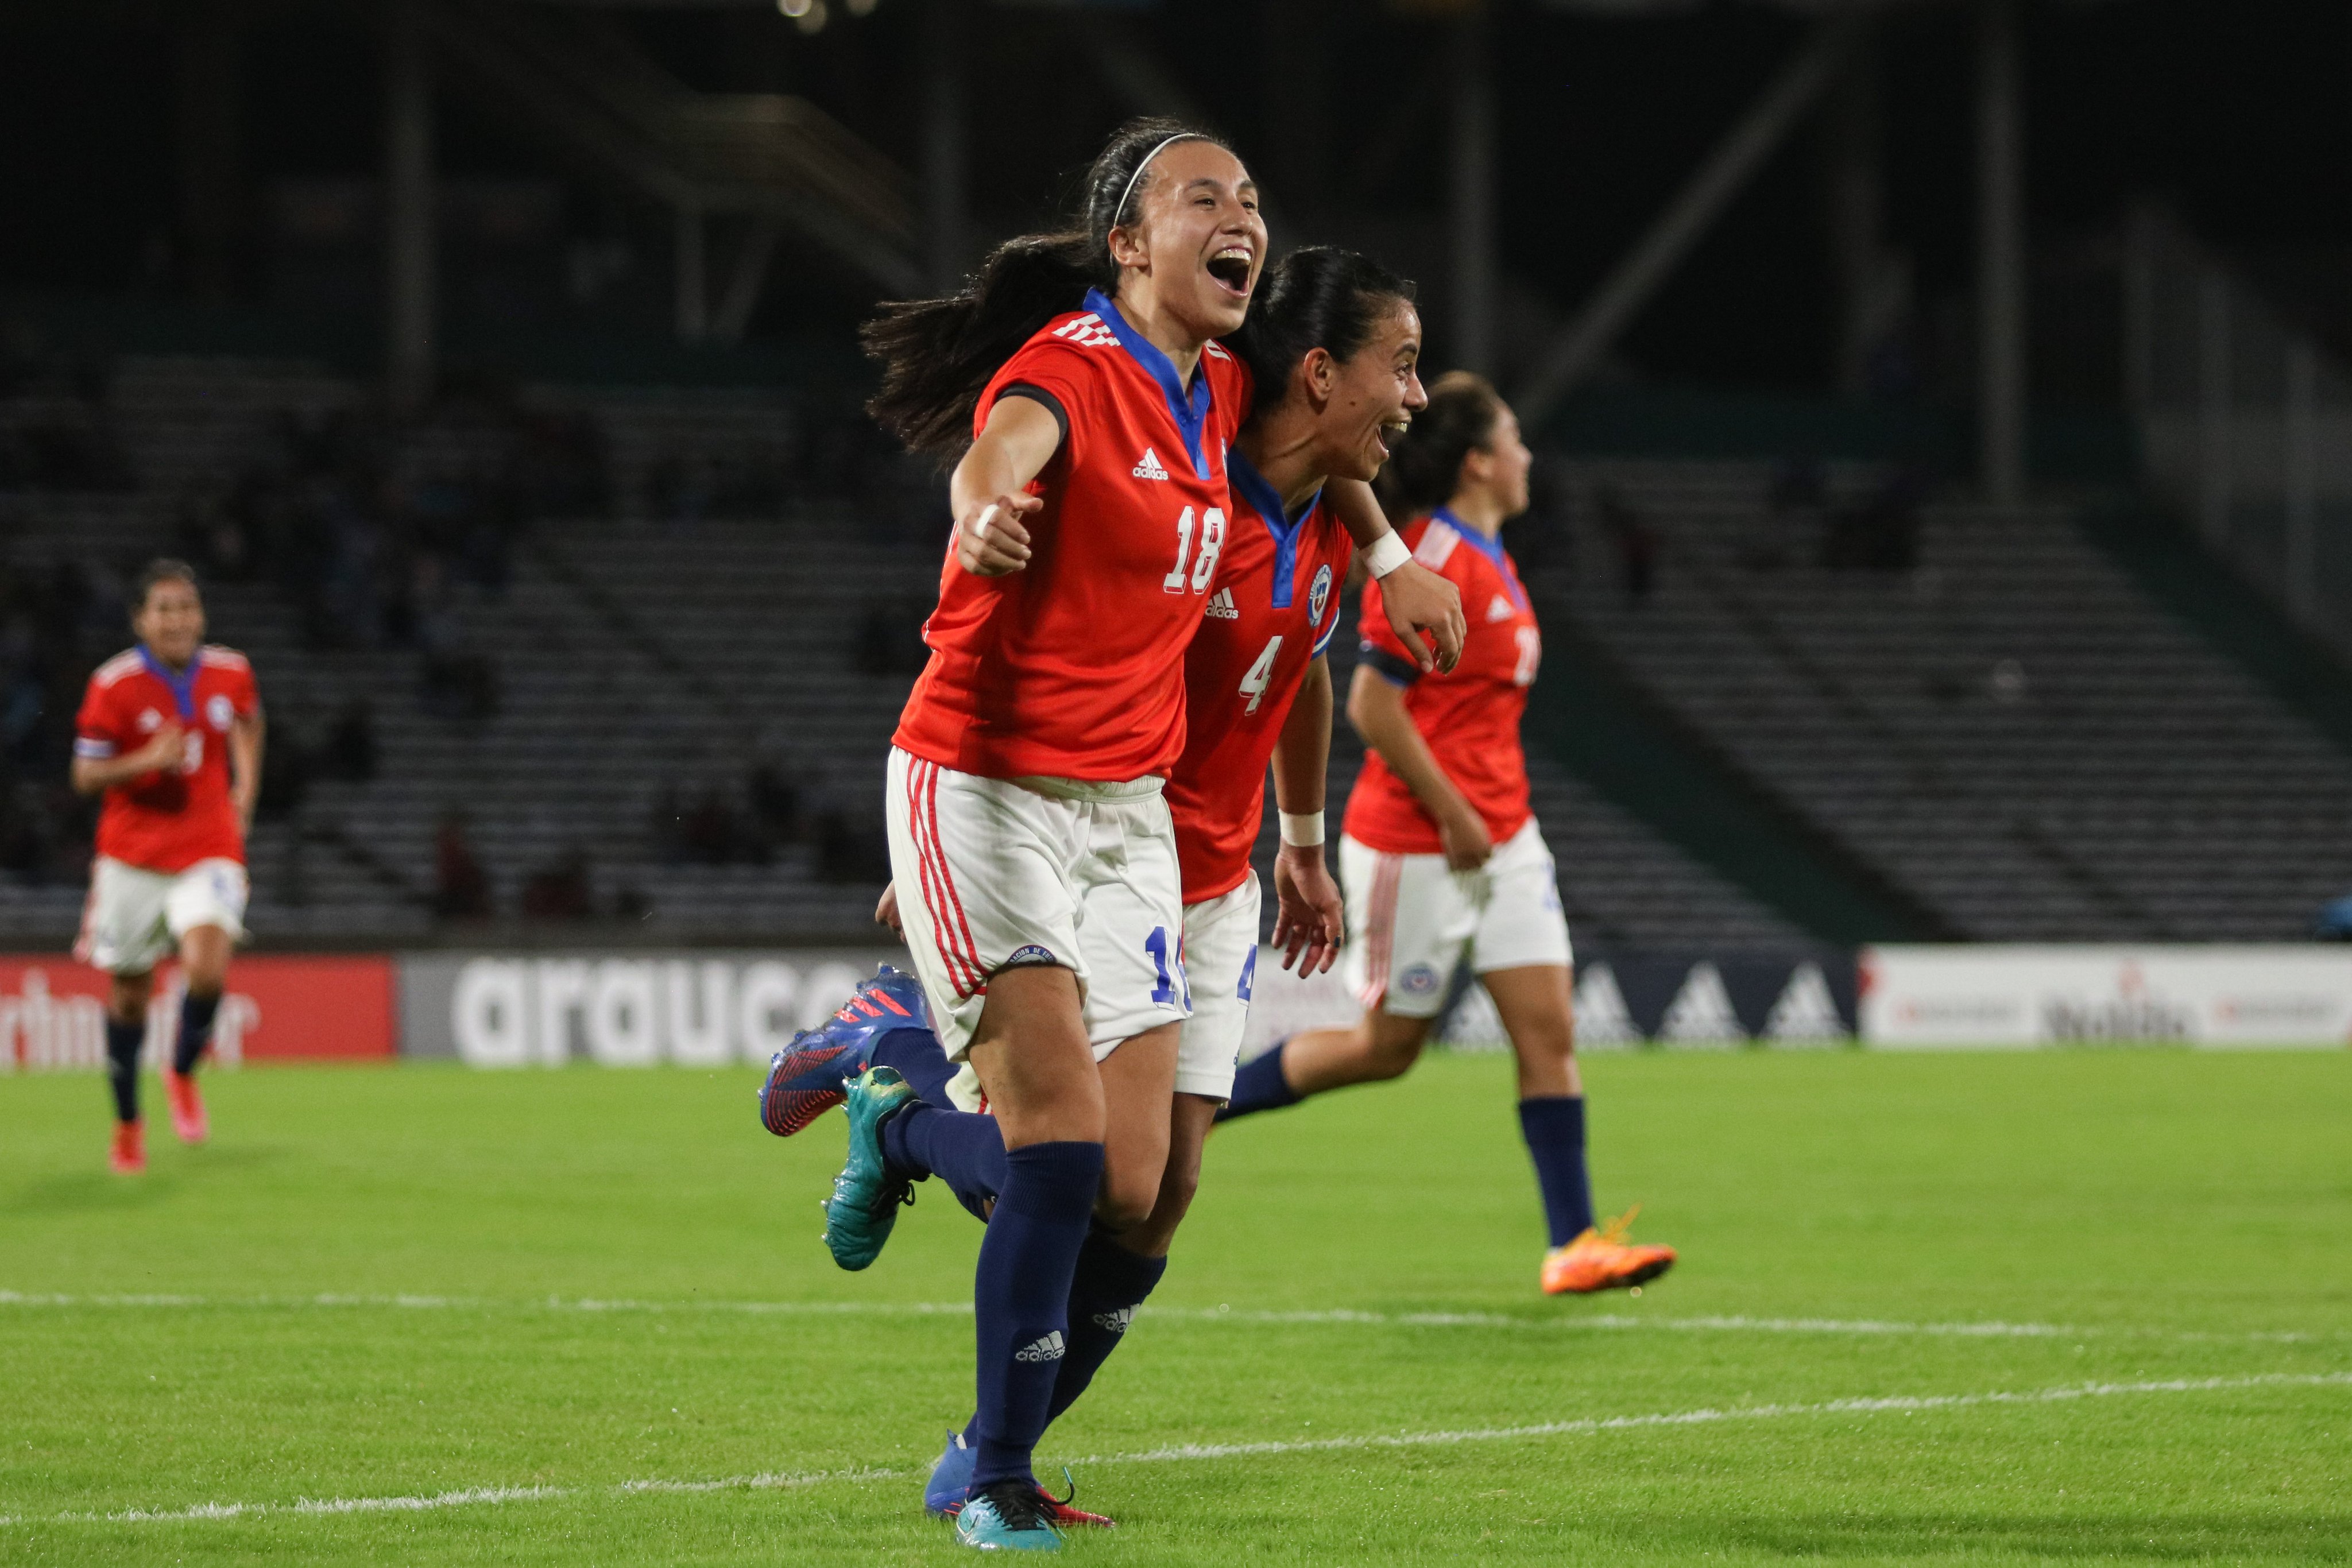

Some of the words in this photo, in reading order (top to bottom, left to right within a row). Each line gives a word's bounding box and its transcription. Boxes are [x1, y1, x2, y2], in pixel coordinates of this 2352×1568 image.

[1132, 466, 1169, 481] adidas
[1163, 505, 1227, 595] 18
[1205, 605, 1239, 620] didas
[1239, 635, 1284, 717] 4
[1009, 947, 1030, 963] RACION
